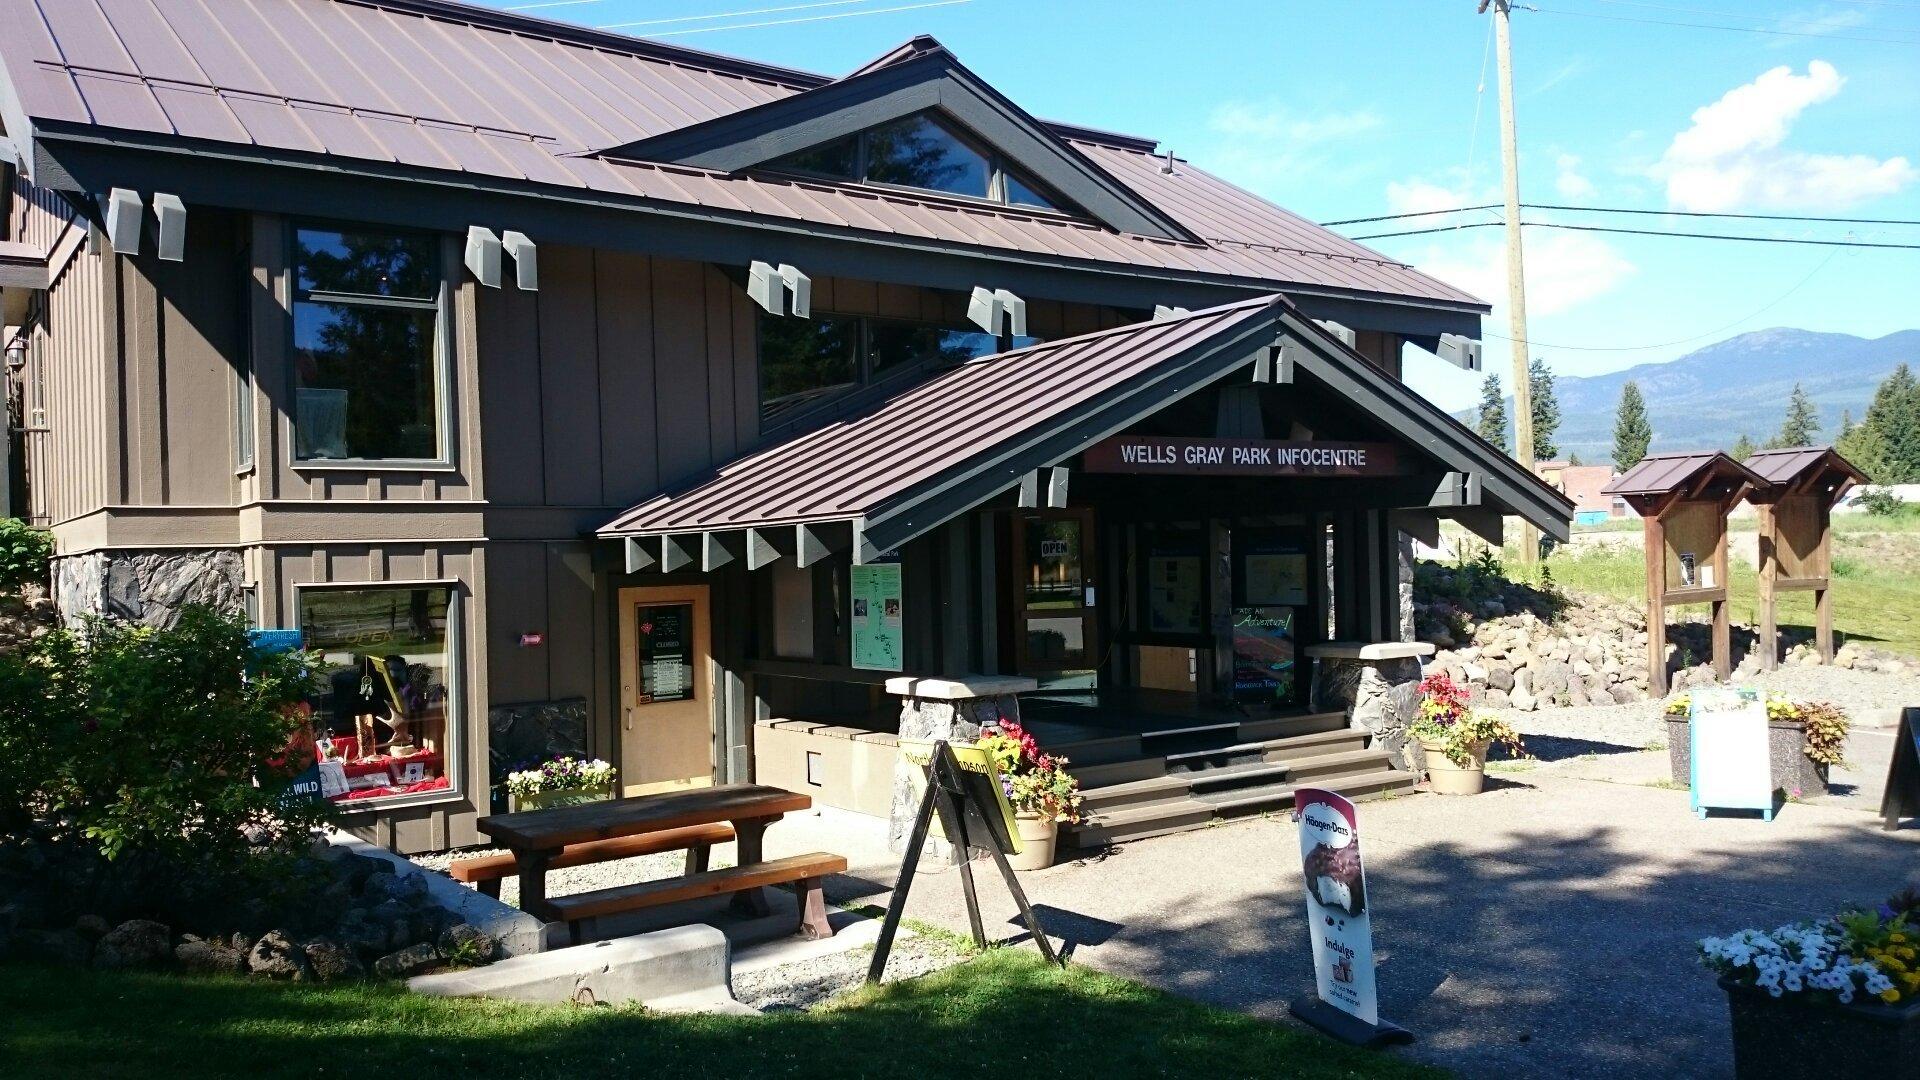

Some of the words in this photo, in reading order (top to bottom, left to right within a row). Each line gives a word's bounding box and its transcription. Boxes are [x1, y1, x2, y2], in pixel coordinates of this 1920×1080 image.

[1121, 445, 1177, 464] WELLS
[1184, 446, 1225, 465] GRAY
[1232, 447, 1271, 465] PARK
[1277, 448, 1366, 467] INFOCENTRE
[1042, 542, 1068, 554] OPEN
[293, 781, 318, 795] WILD
[1305, 814, 1349, 836] Häagen-Dazs
[1325, 937, 1355, 959] Indulge
